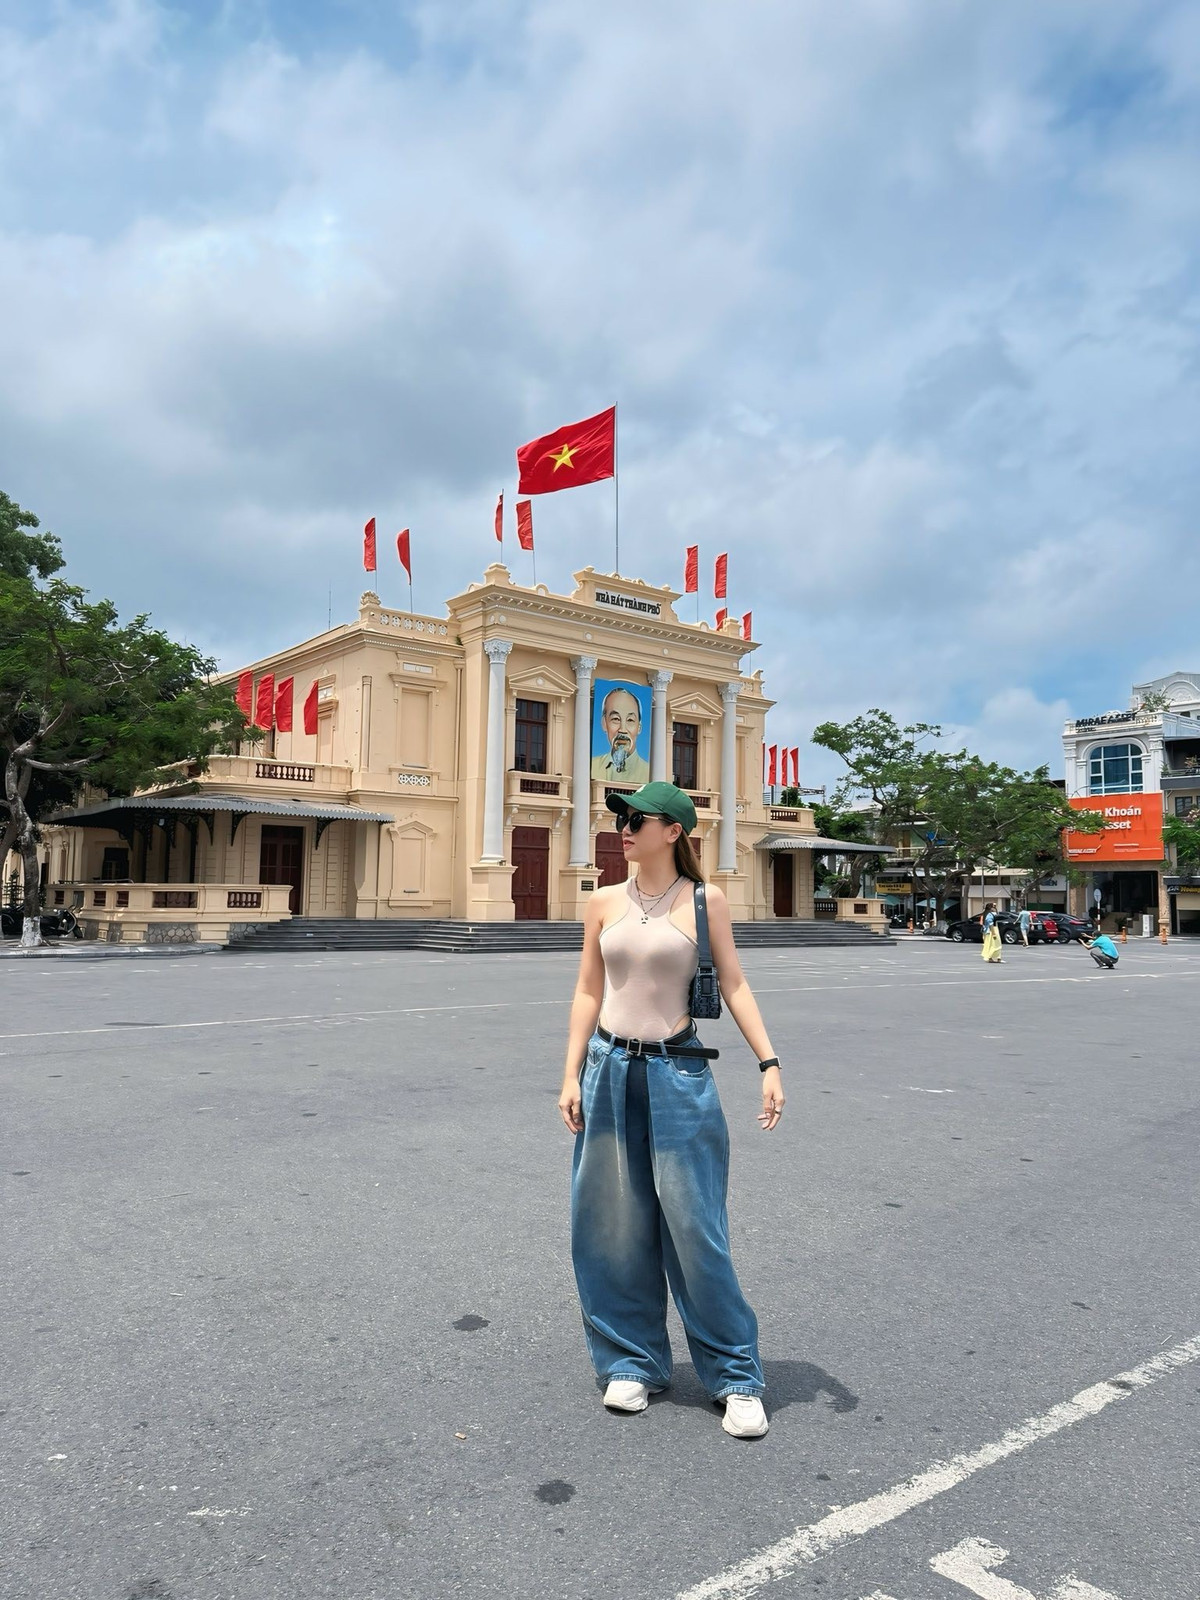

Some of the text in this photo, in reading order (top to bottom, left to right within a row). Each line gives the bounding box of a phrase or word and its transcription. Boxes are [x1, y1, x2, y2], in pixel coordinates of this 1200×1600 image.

[596, 592, 662, 615] NHÀ HÁT THÀNH PHỐ
[1076, 716, 1106, 728] MIRAE
[1104, 805, 1142, 817] Khoán
[1104, 820, 1132, 830] sset
